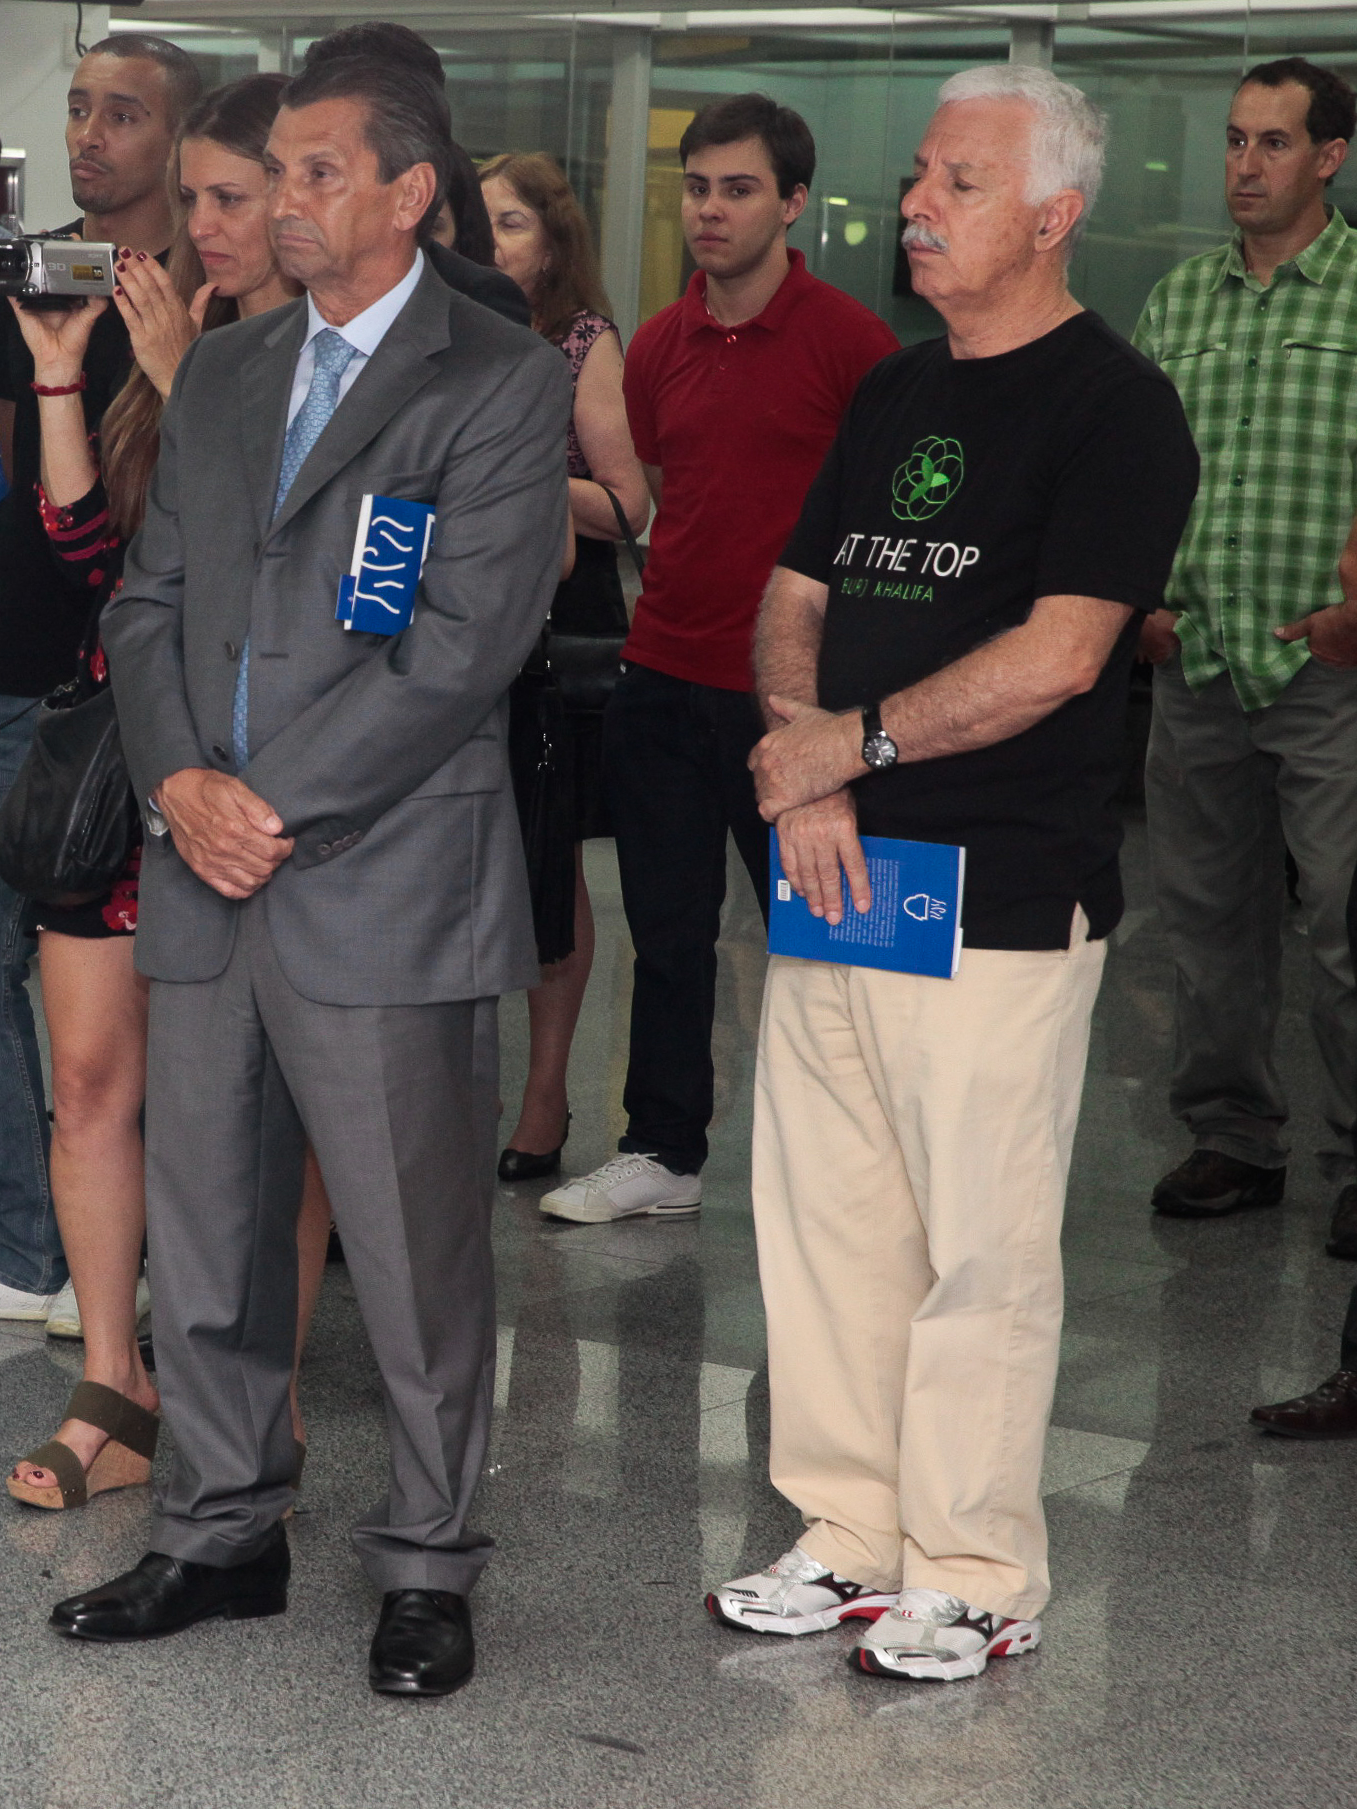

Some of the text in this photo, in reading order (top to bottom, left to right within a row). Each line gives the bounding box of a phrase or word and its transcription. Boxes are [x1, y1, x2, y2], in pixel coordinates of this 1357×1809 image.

[833, 533, 981, 578] AT THE TOP
[873, 583, 935, 603] KHALIFA
